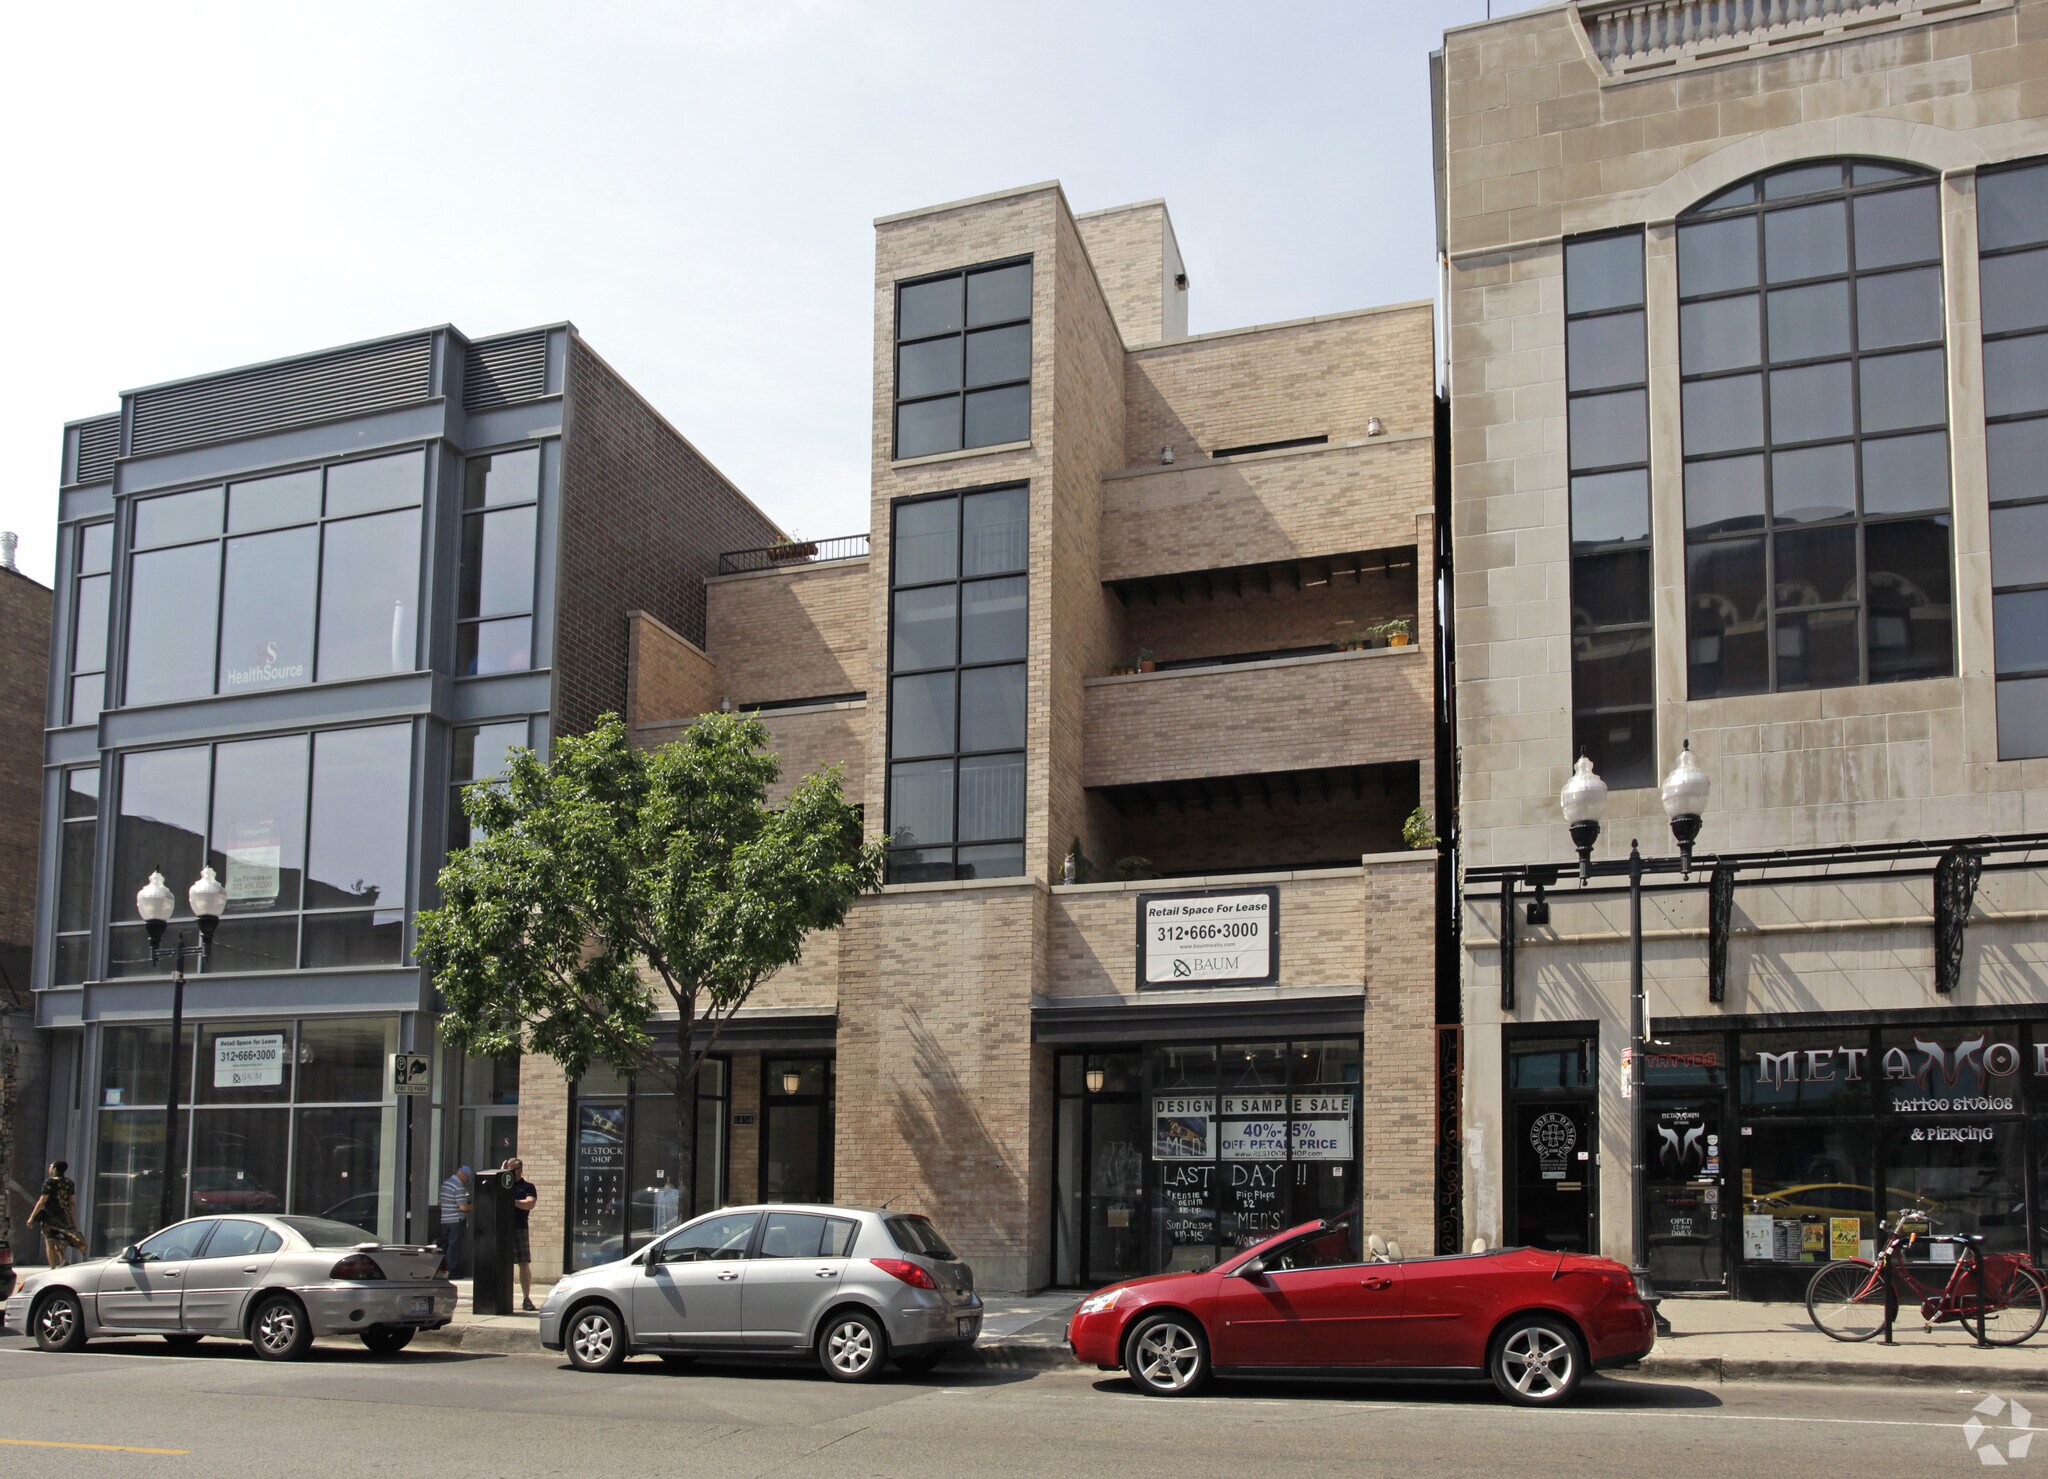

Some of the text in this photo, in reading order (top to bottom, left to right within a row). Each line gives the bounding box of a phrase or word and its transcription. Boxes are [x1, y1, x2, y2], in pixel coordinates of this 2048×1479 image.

[227, 664, 304, 685] HealthSource
[1149, 903, 1268, 917] Retail Space For Lease
[1180, 941, 1236, 949] www.baumrealty.com
[1194, 956, 1240, 971] BAUM
[236, 1039, 252, 1047] Space
[1645, 1053, 1717, 1068] TATTOO
[1157, 1098, 1350, 1113] DESIGNR SAMPE SALE
[1911, 1128, 1924, 1141] &
[1300, 1139, 1337, 1149] PRICE
[591, 1155, 612, 1163] SHOP
[505, 1174, 512, 1186] P
[1163, 1165, 1215, 1188] LAST
[1232, 1164, 1283, 1187] DAY
[1236, 1190, 1276, 1202] Flip Flops
[1243, 1199, 1256, 1208] $2
[1166, 1219, 1181, 1230] Sun
[1671, 1229, 1692, 1237] DAILY
